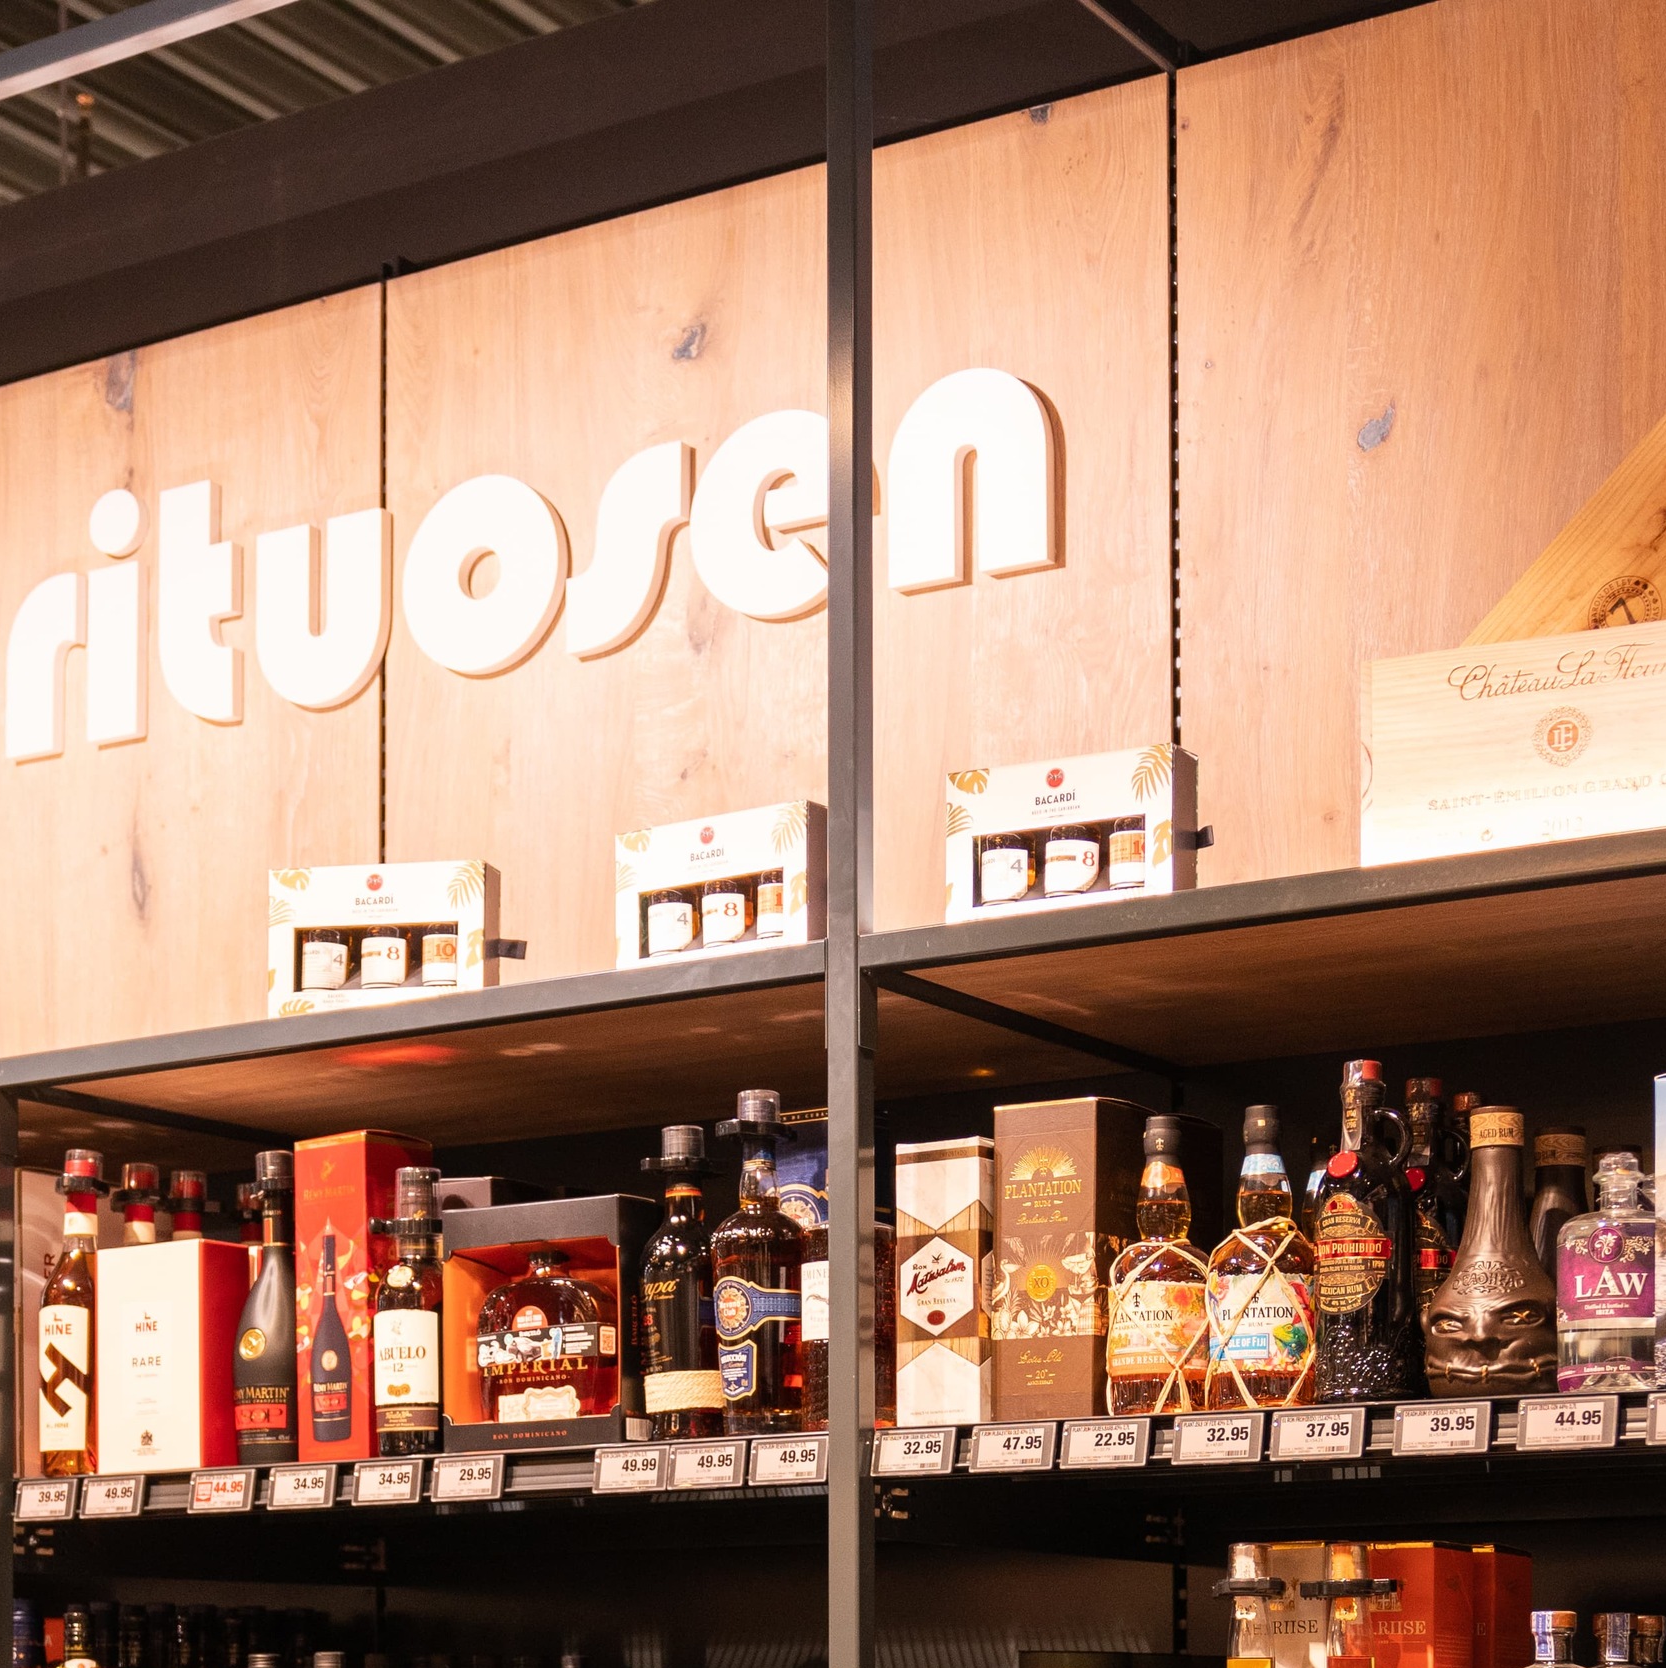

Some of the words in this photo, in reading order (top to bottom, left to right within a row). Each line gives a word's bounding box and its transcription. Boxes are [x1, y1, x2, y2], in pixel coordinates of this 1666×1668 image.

[1583, 774, 1653, 795] GRAND
[1035, 789, 1077, 808] BACARDÍ
[690, 845, 725, 863] BACARDÍ
[354, 896, 395, 909] BACARDÍ
[1004, 1177, 1082, 1200] PLANTATION
[1034, 1276, 1050, 1289] XO
[1575, 1265, 1647, 1298] LAW
[45, 1323, 72, 1336] HINE
[135, 1321, 158, 1333] HINE
[379, 1345, 426, 1361] ABUELO
[132, 1356, 162, 1368] RARE
[483, 1357, 588, 1377] IMPERIAL
[1555, 1411, 1601, 1426] 44.95
[1306, 1422, 1350, 1438] 37.95
[903, 1440, 941, 1454] 32.95
[1003, 1436, 1042, 1451] 47.95
[1095, 1432, 1135, 1447] 22.95
[622, 1458, 657, 1472] 49.99
[698, 1453, 733, 1468] 49.95
[460, 1468, 491, 1481] 29.95
